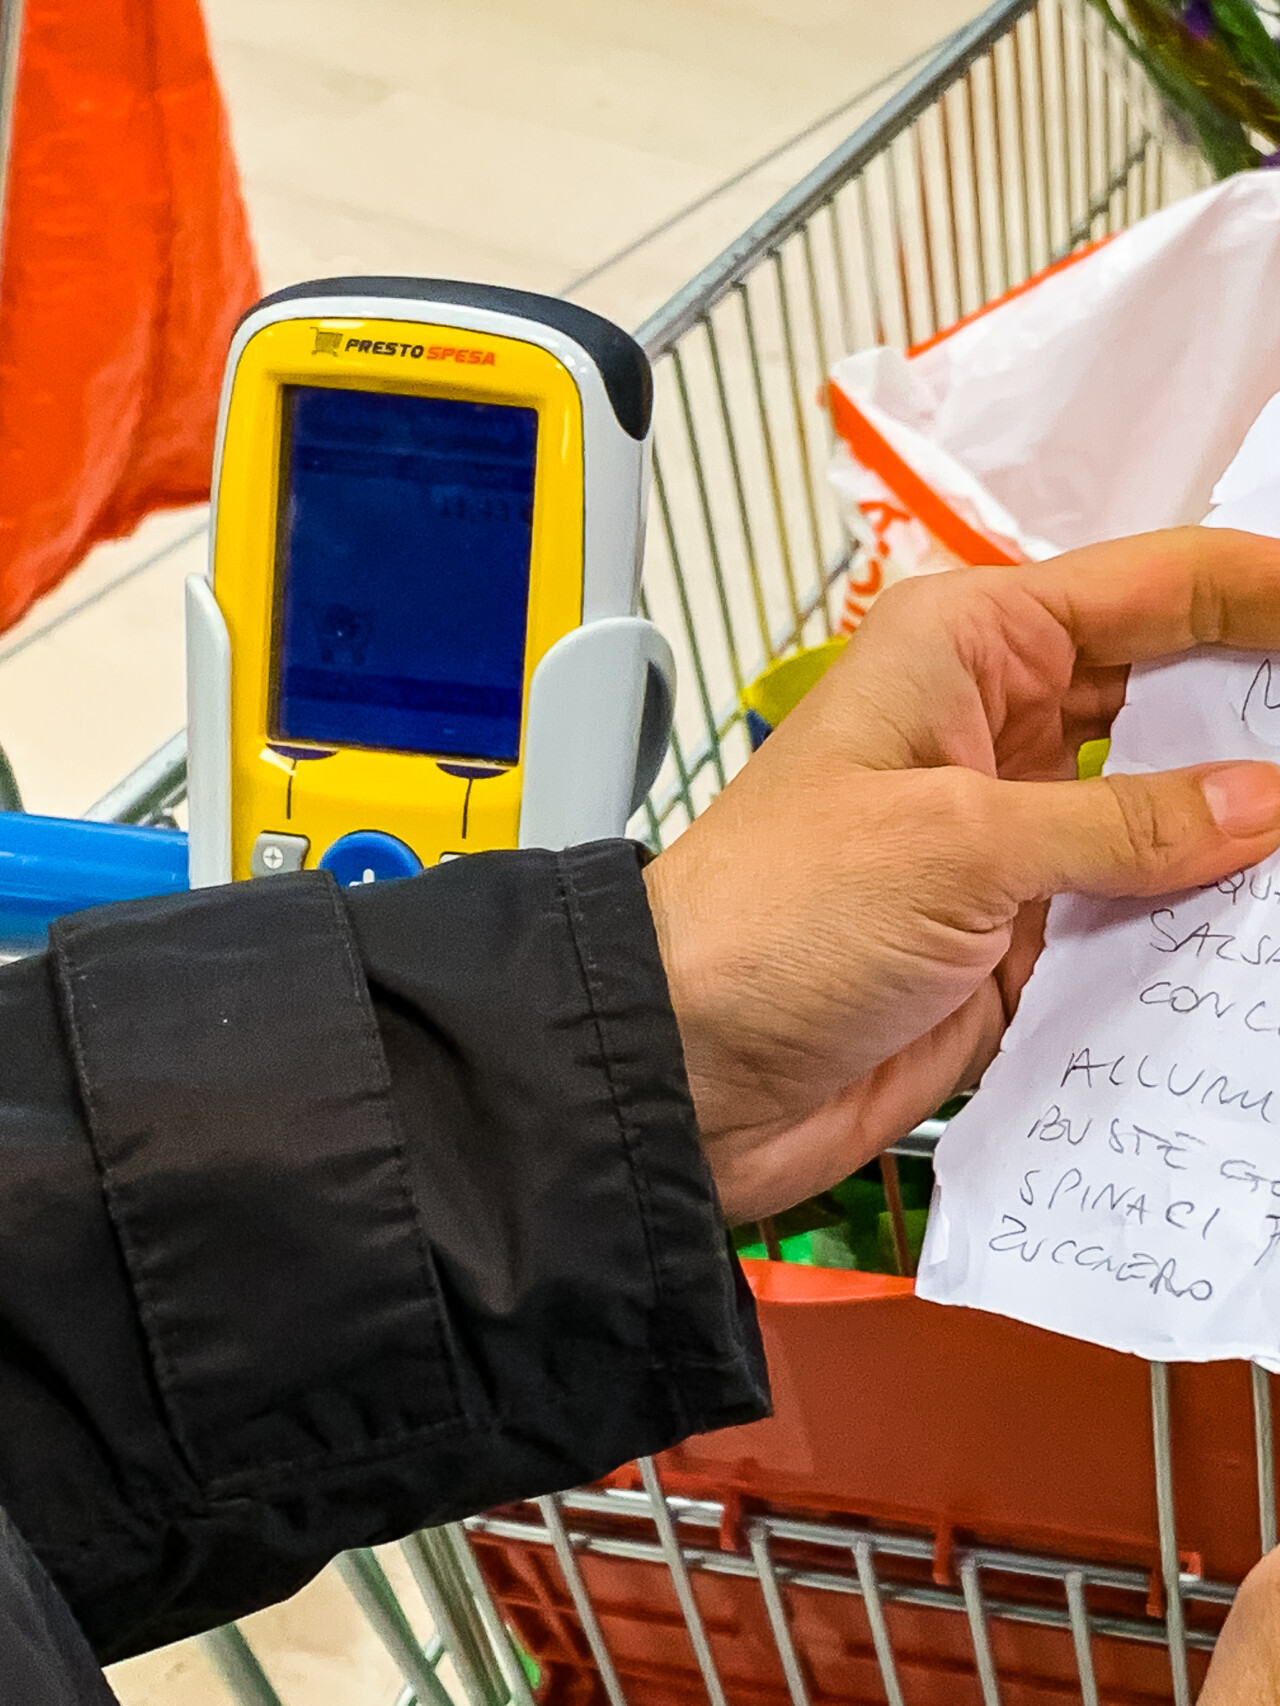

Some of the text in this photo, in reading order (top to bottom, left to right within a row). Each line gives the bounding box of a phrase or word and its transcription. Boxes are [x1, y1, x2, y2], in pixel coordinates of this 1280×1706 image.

[1026, 1105, 1206, 1169] BUSTE
[1019, 1168, 1221, 1239] SPINACI
[988, 1215, 1212, 1301] ZUCCHERO
